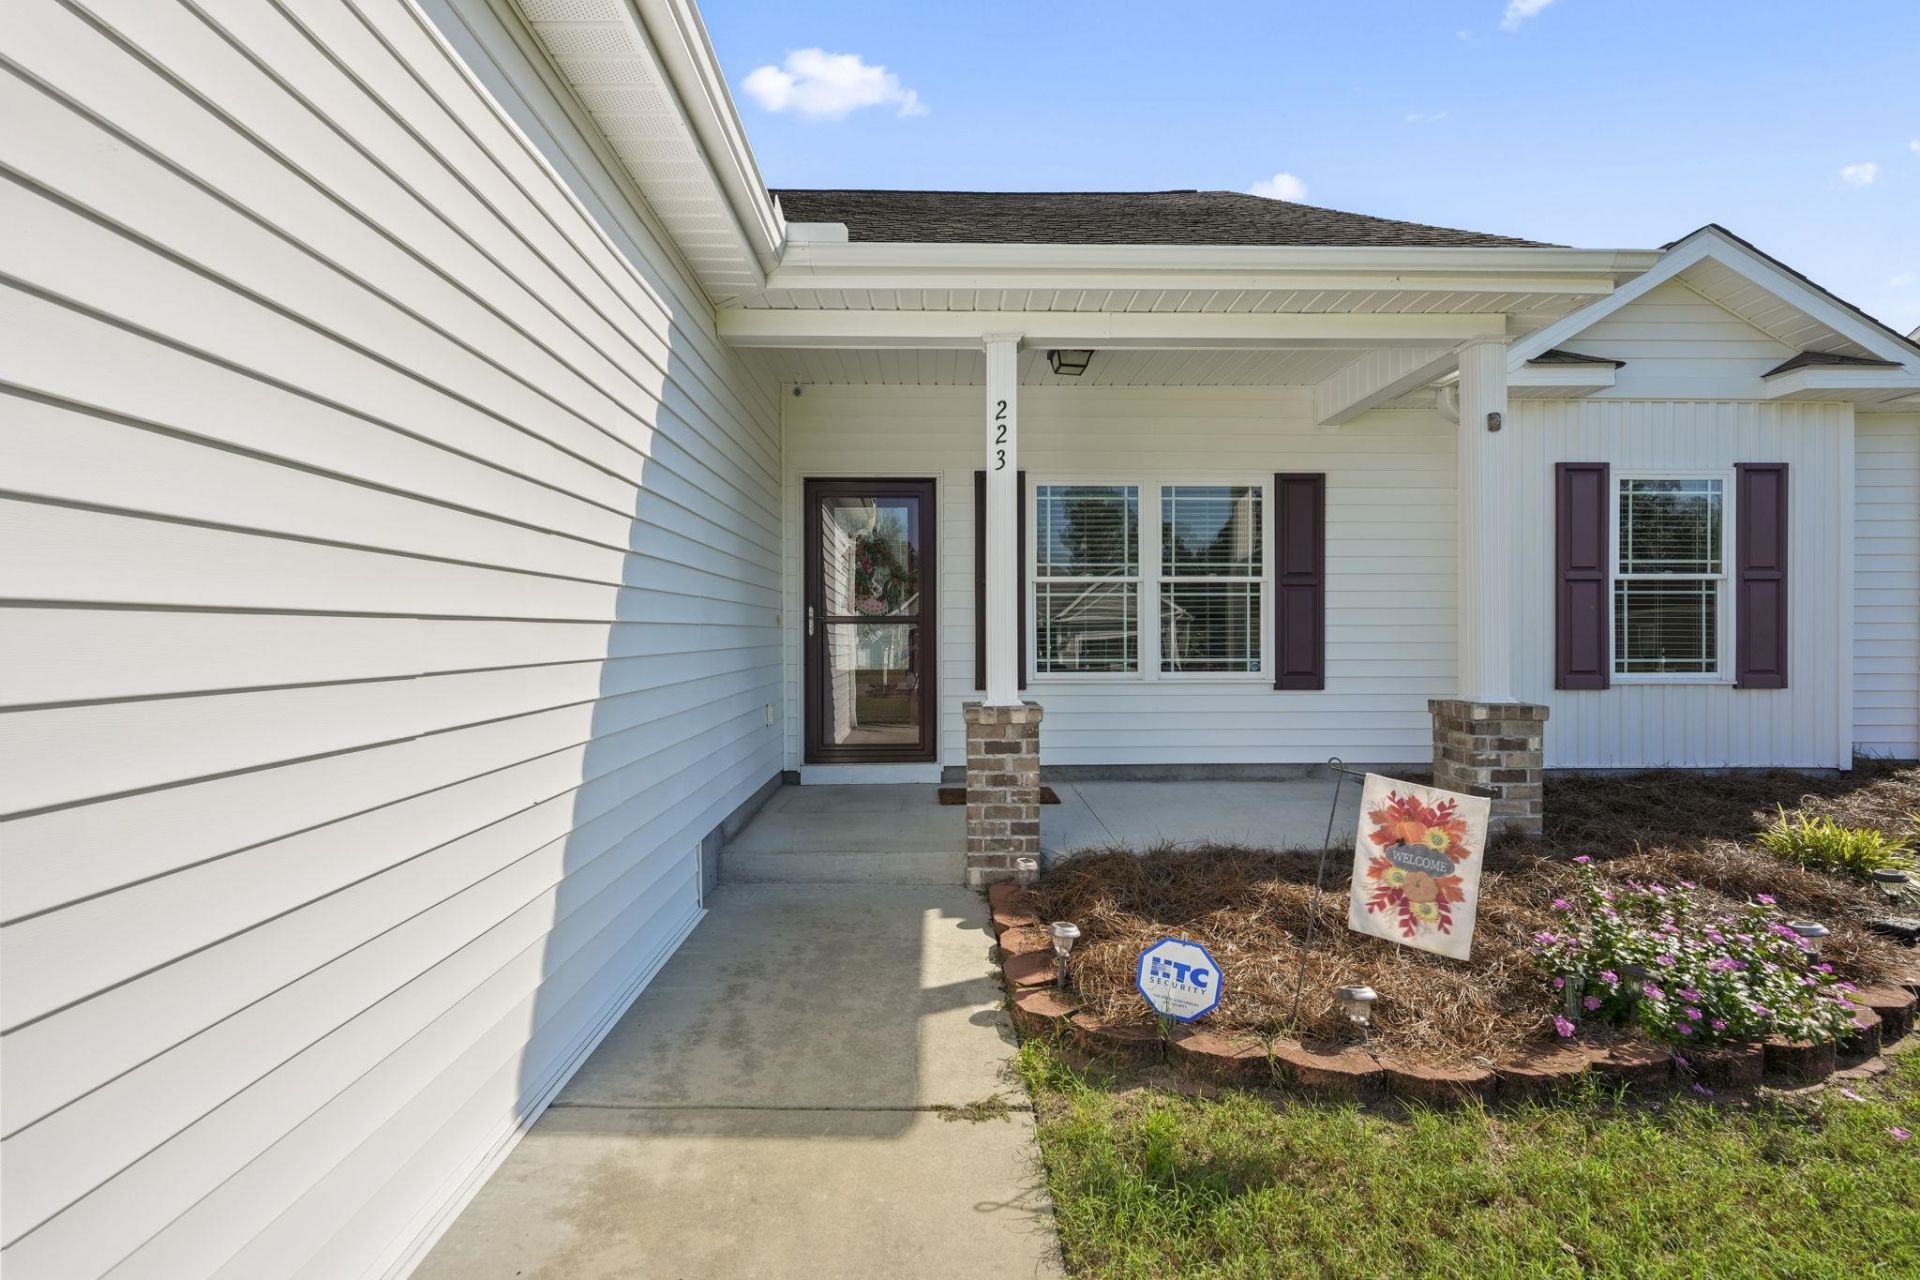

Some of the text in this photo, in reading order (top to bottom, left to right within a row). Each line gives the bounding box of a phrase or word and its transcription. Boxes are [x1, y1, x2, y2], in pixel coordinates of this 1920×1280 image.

[995, 400, 1008, 471] 223
[1392, 850, 1447, 872] WELCOME
[1149, 976, 1207, 996] SECURITY
